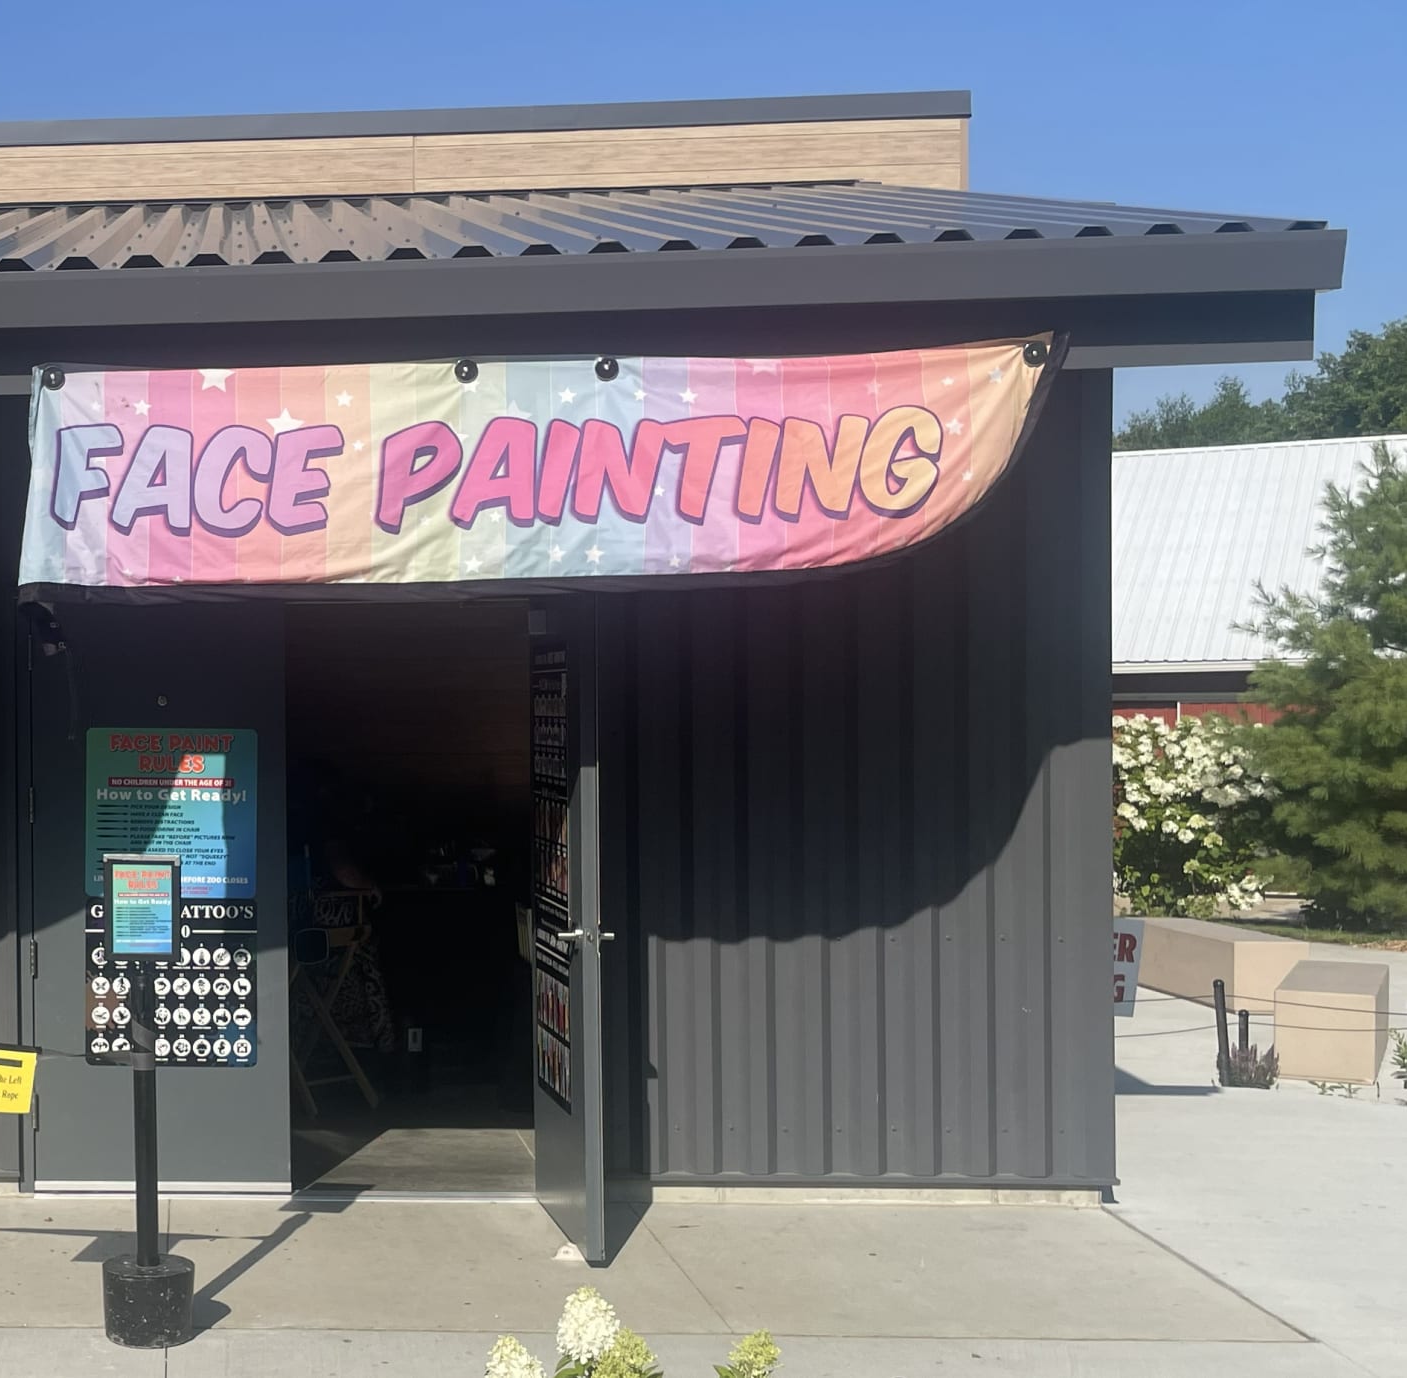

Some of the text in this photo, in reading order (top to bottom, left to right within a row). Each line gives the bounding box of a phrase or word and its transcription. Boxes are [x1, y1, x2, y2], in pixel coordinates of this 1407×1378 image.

[51, 405, 943, 537] FACE PAINTING
[109, 734, 234, 752] FACE PAINT
[138, 753, 205, 773] RULES
[111, 779, 122, 787] NO
[123, 779, 158, 787] CHILDREN
[159, 779, 183, 787] UNDER
[184, 779, 197, 787] THE
[198, 779, 212, 787] AGE
[213, 779, 223, 787] OF
[96, 788, 247, 805] How to Get Ready!
[207, 876, 222, 884] ZOO
[181, 905, 254, 919] ATTOO'S
[8, 1075, 22, 1085] Left
[2, 1090, 19, 1101] Rope
